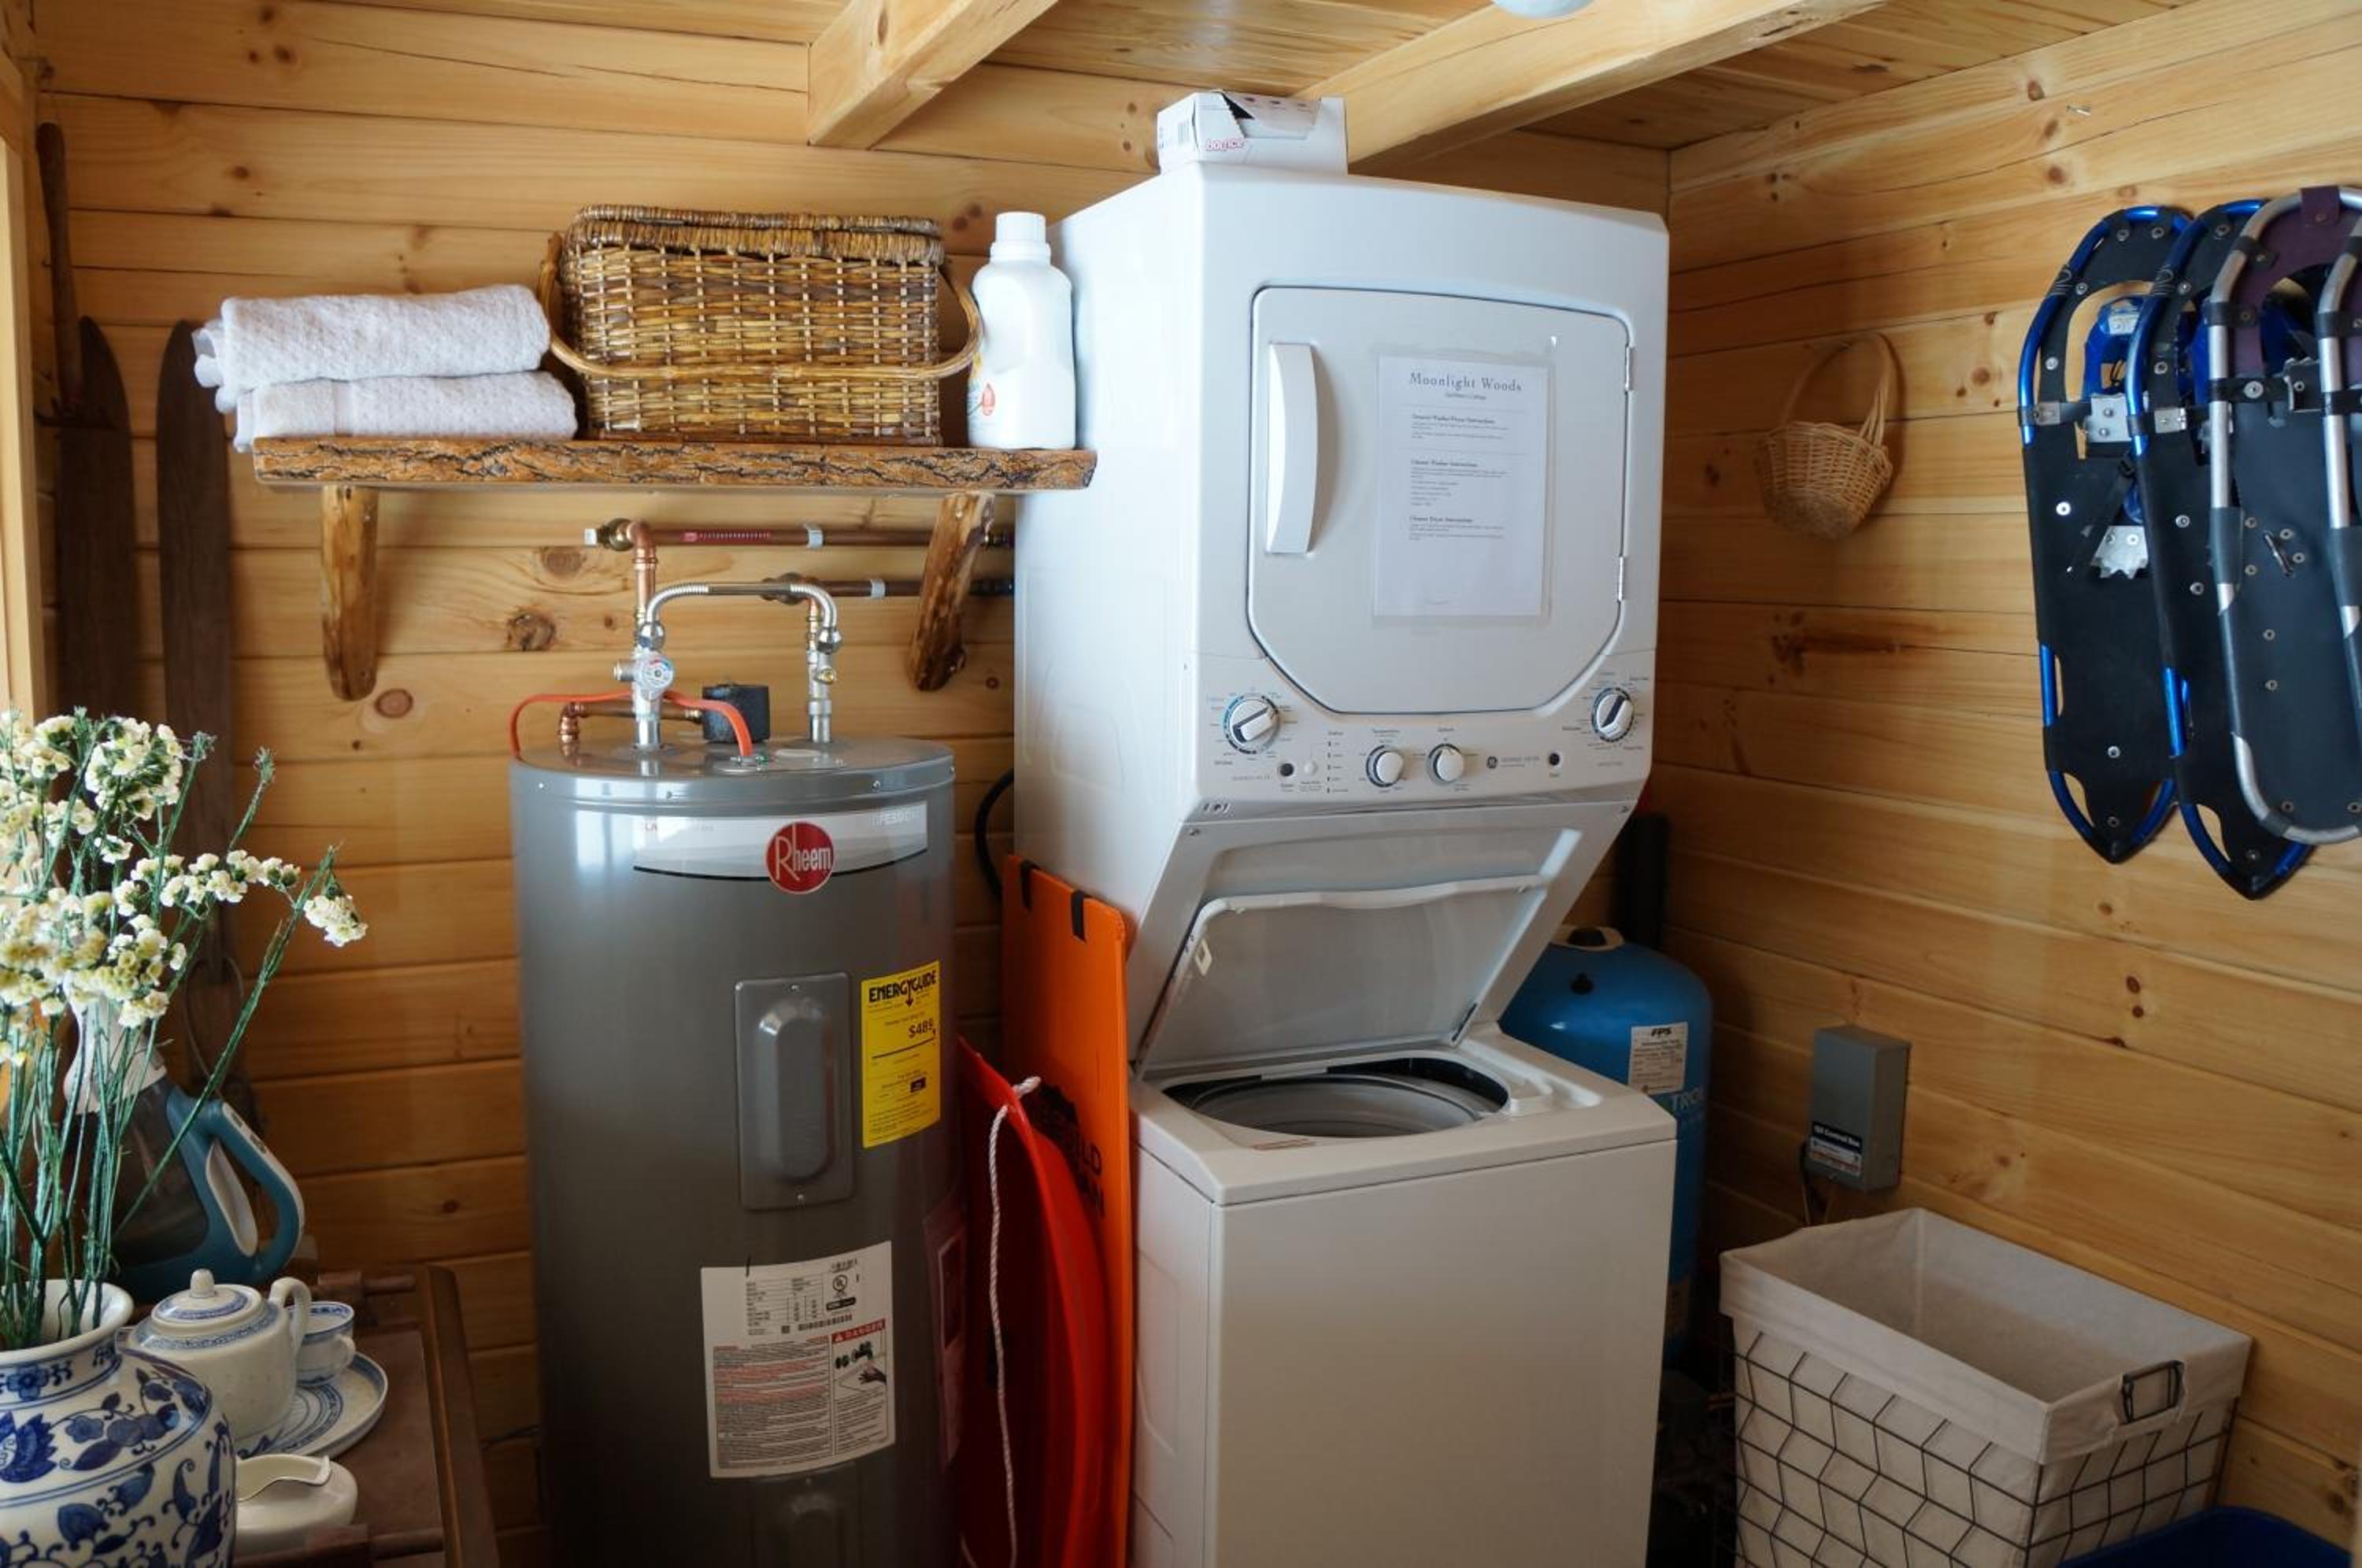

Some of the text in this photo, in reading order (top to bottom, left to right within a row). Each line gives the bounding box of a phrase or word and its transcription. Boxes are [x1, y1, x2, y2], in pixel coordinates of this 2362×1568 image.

[1410, 372, 1522, 391] Moonlight Woods
[775, 823, 832, 882] Rheem
